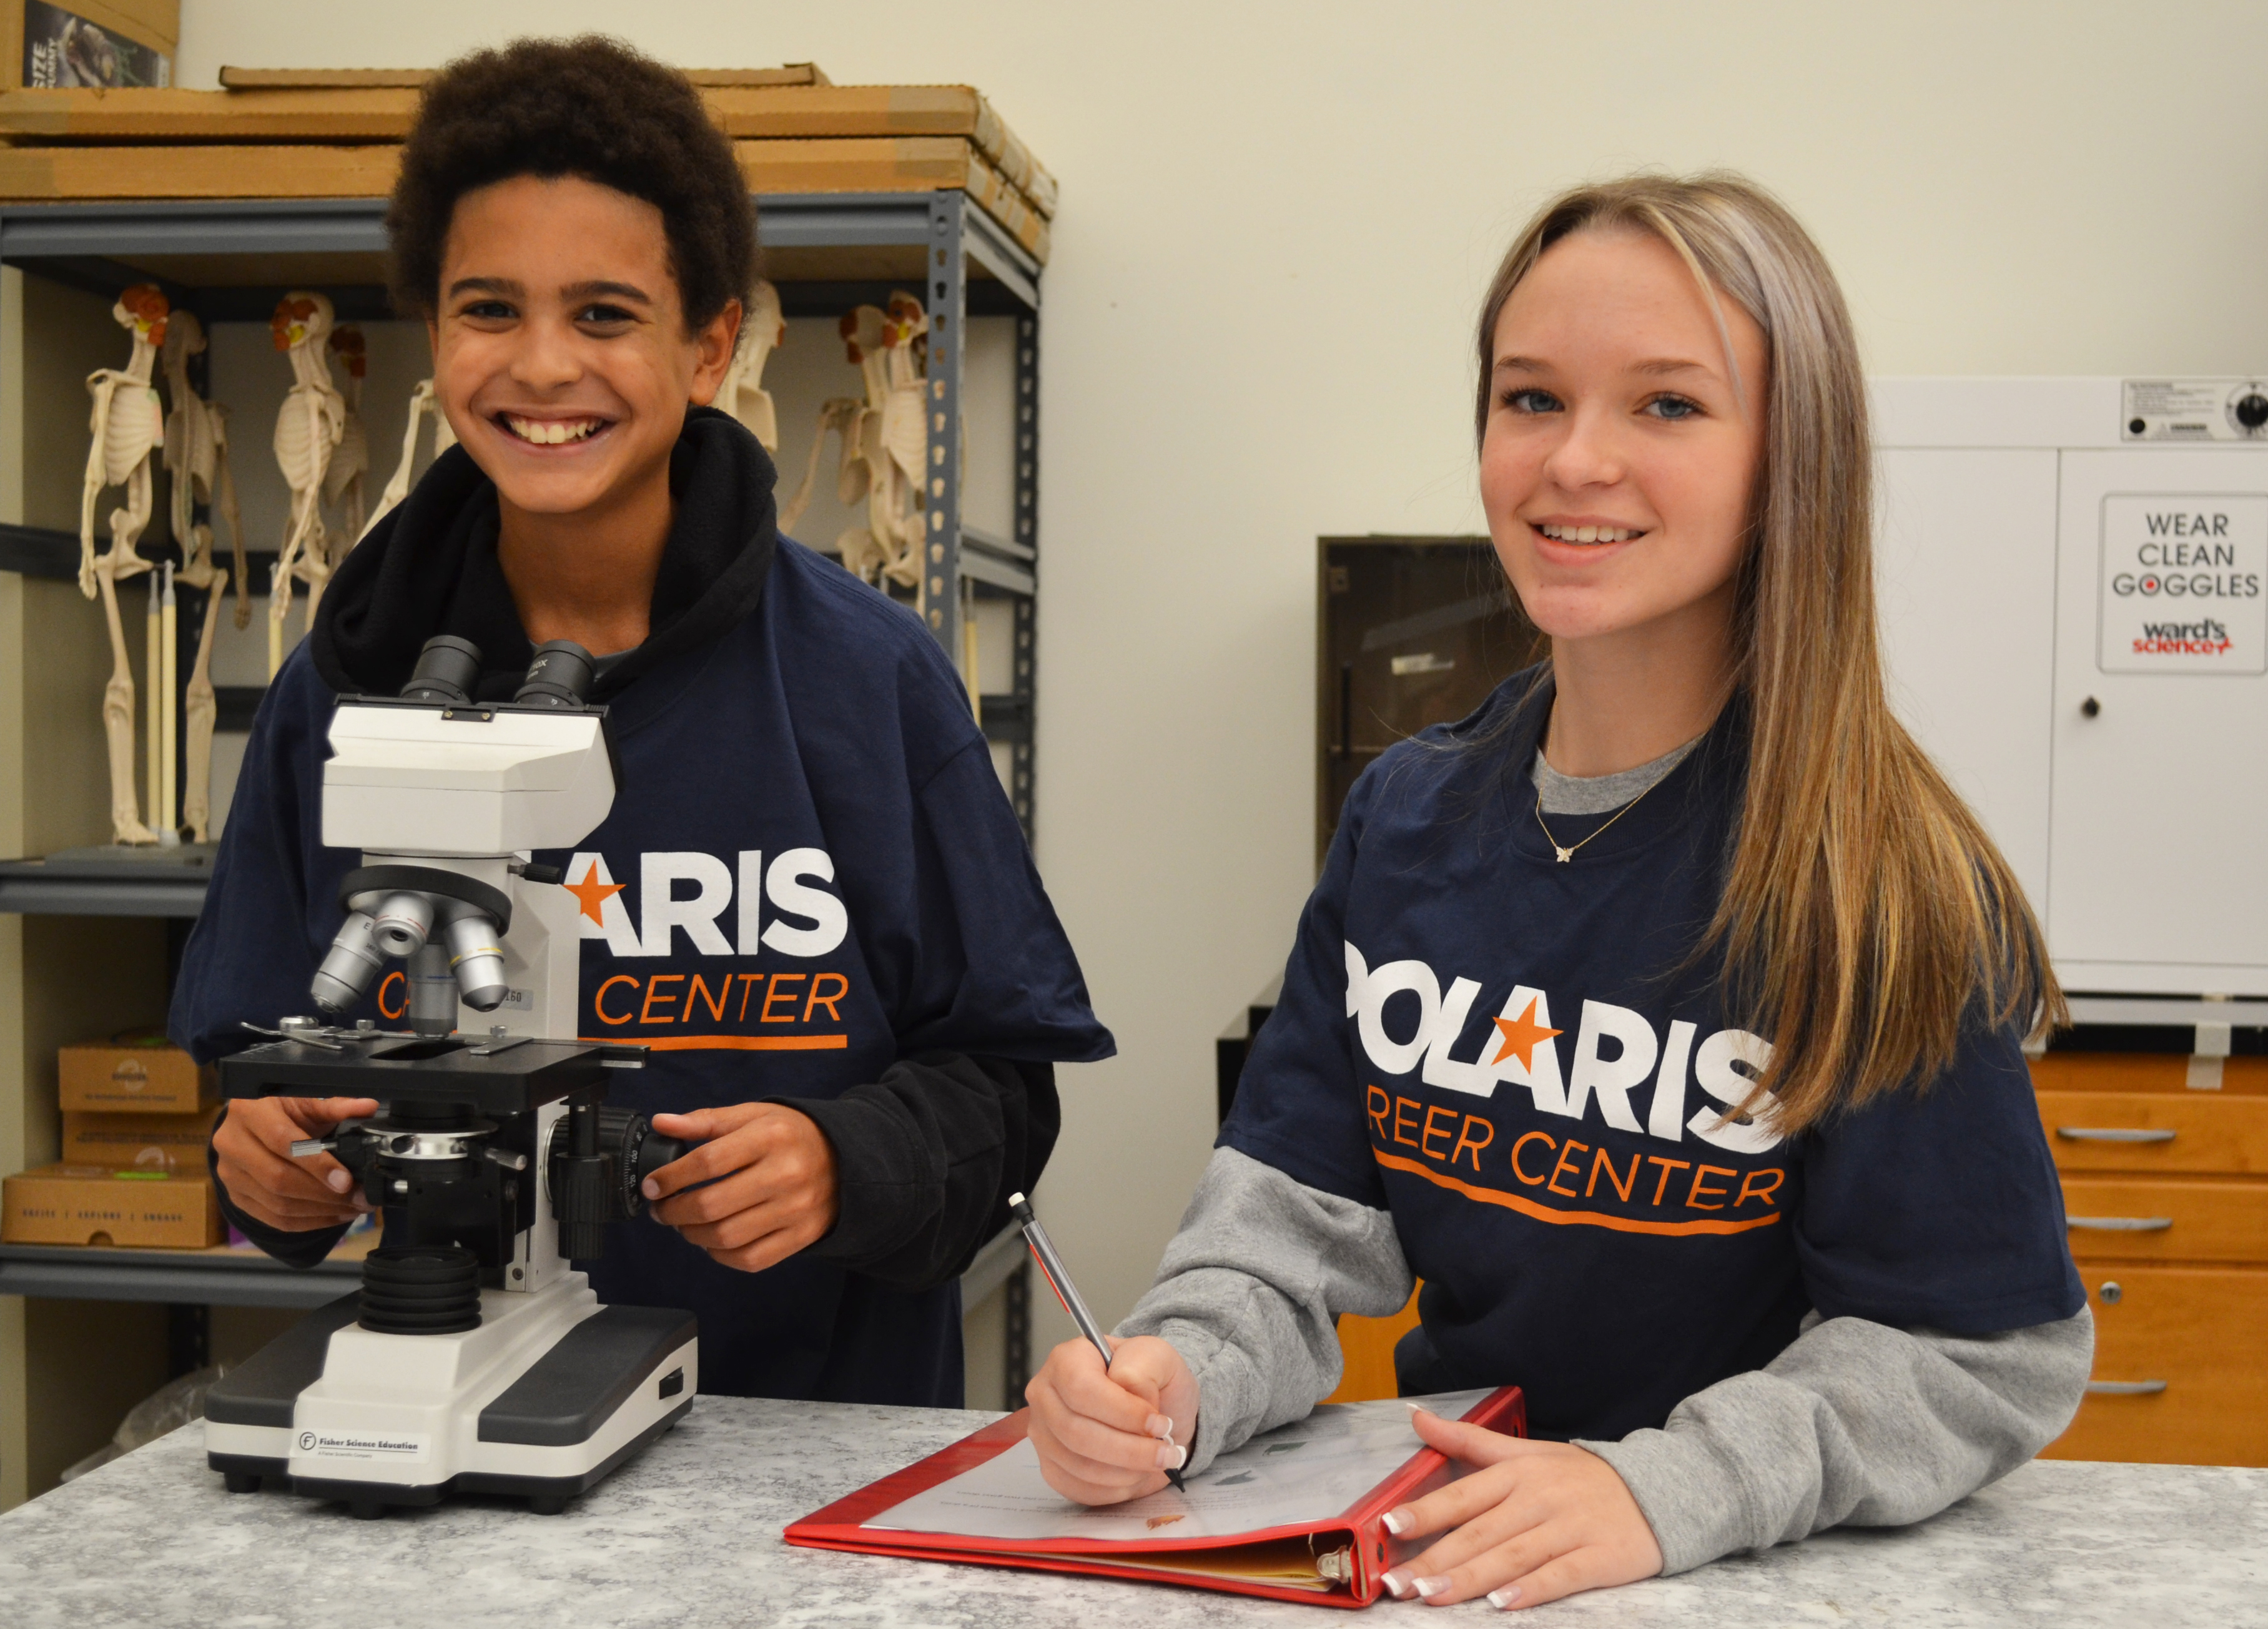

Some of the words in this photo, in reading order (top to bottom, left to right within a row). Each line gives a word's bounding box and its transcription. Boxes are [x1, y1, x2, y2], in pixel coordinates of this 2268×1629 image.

[32, 41, 47, 87] SIZE
[2146, 513, 2229, 536] WEAR
[2138, 543, 2234, 566] CLEAN
[2113, 573, 2259, 597] GOGGLES
[2142, 618, 2226, 639] ward's
[563, 847, 849, 958] ARIS
[595, 972, 849, 1025] CENTER
[1368, 1084, 1495, 1171] REER
[1510, 1131, 1785, 1211] CENTER
[319, 1438, 344, 1446] Fisher
[346, 1439, 375, 1448] Science
[378, 1441, 418, 1450] Education
